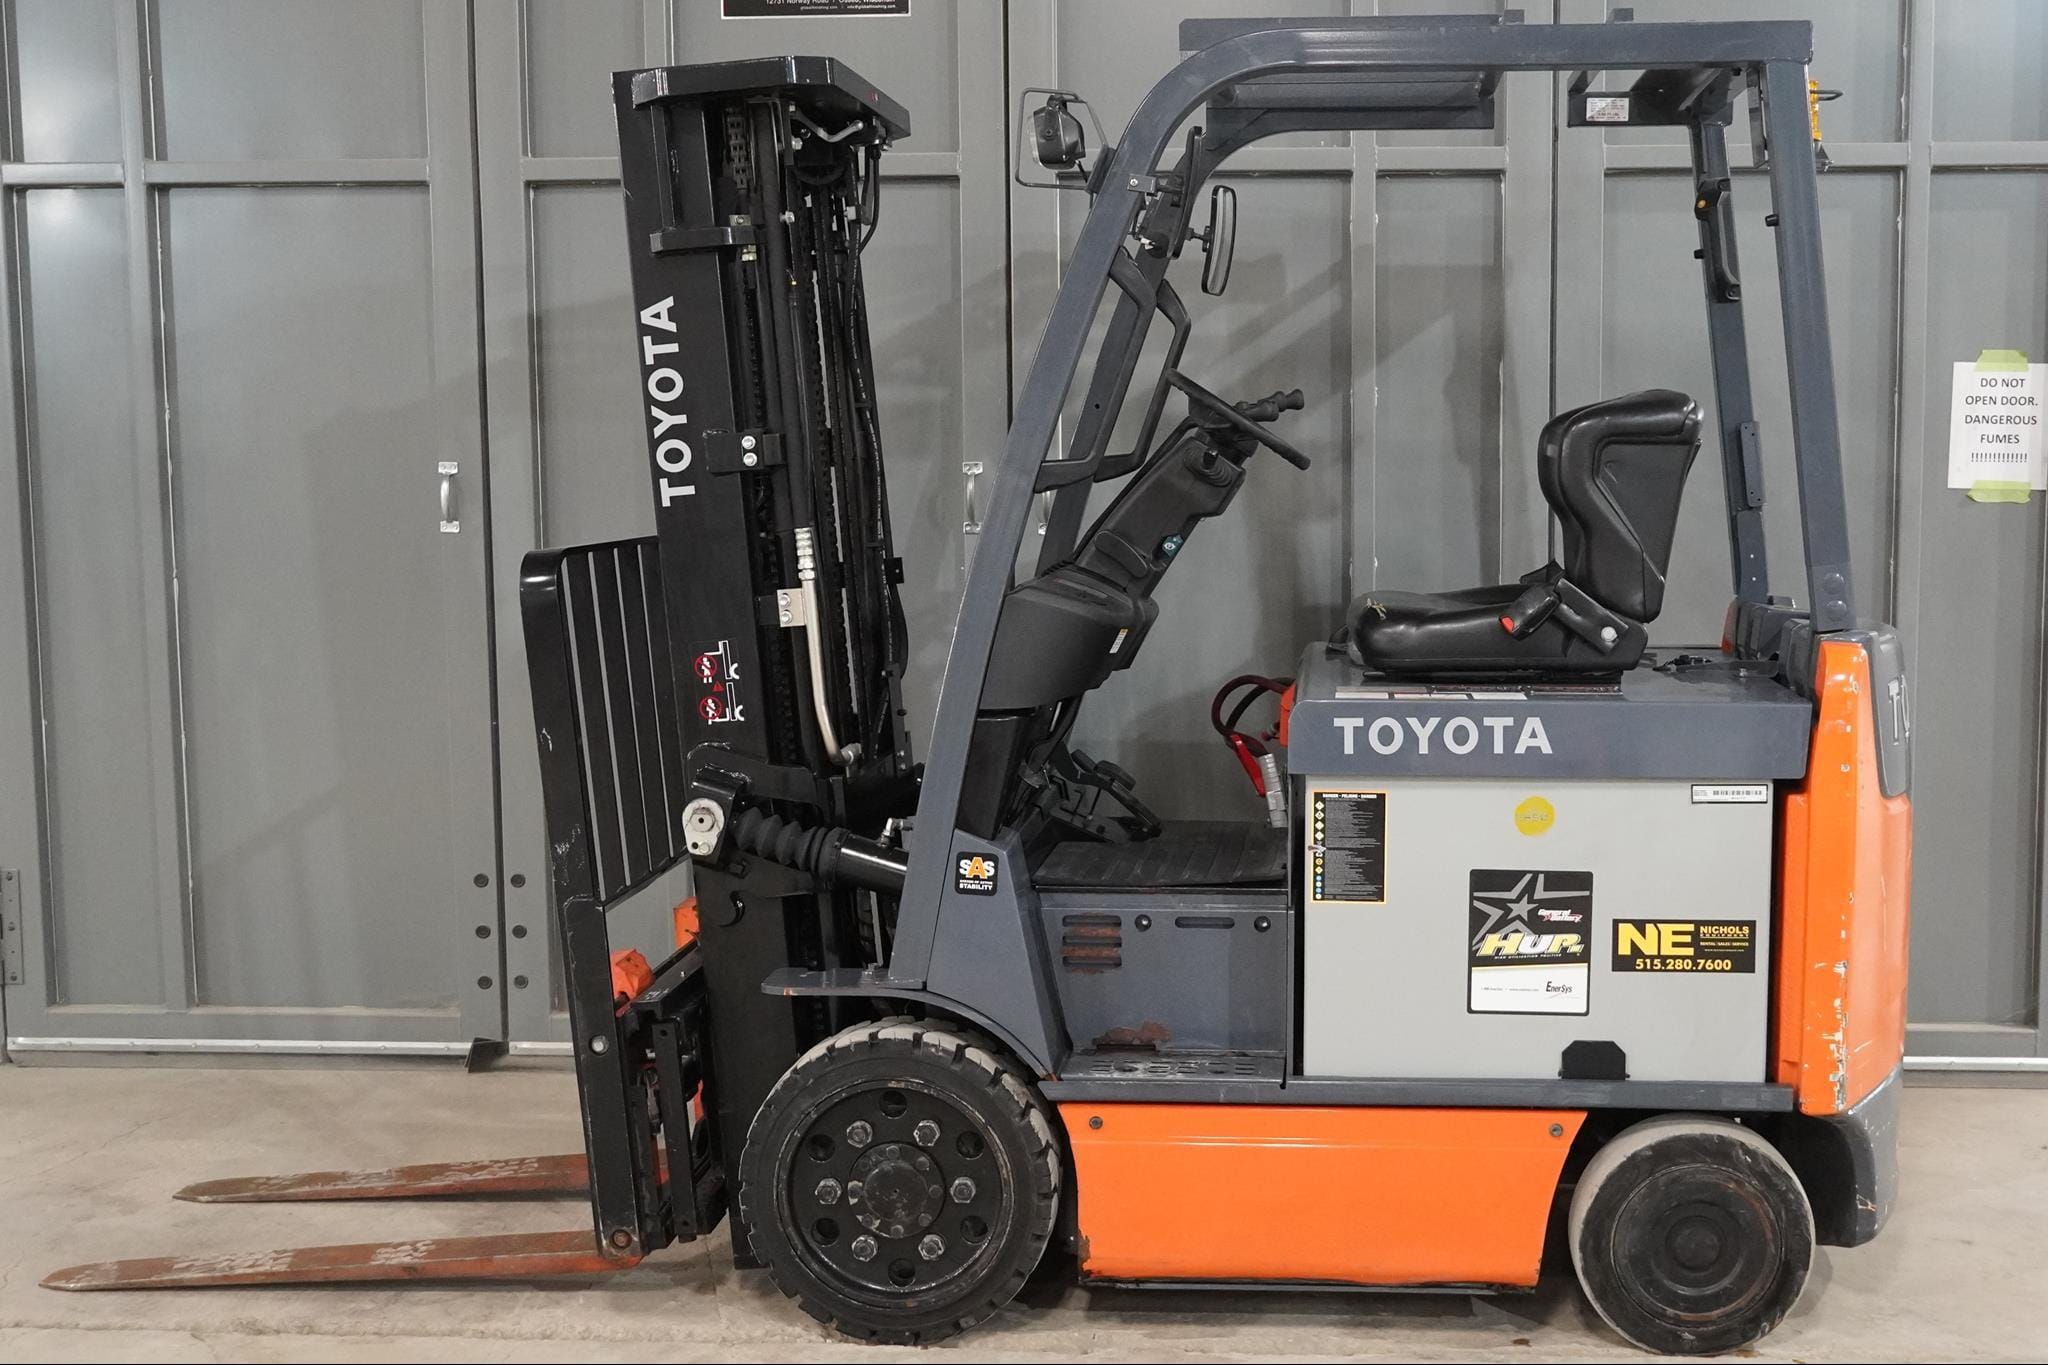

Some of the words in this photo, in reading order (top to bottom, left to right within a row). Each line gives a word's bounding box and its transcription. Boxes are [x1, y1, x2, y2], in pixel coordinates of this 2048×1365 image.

[1980, 378, 1998, 388] DO
[2001, 378, 2026, 388] NOT
[640, 296, 696, 507] TOYOTA
[1965, 395, 1998, 405] OPEN
[2001, 396, 2039, 406] DOOR.
[1964, 415, 2038, 425] DANGEROUS
[1980, 434, 2020, 444] FUMES
[1333, 716, 1553, 755] TOYOTA
[959, 856, 995, 879] SAS
[1618, 923, 1695, 956] NE
[1700, 926, 1750, 934] NICHOLS
[1635, 958, 1732, 970] 515.280.7600
[1545, 980, 1573, 994] EnerSys
